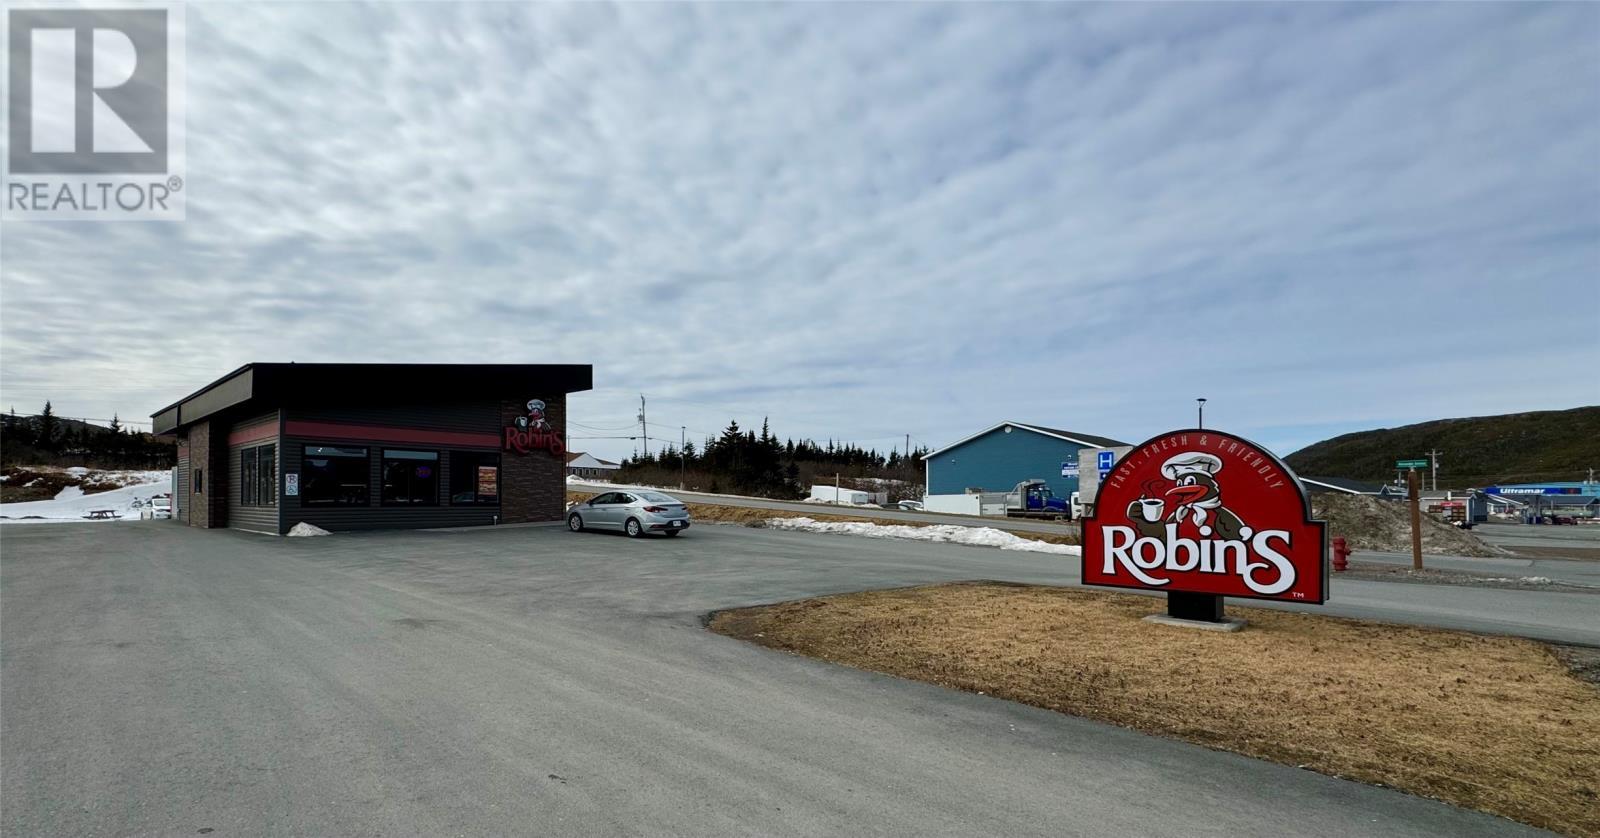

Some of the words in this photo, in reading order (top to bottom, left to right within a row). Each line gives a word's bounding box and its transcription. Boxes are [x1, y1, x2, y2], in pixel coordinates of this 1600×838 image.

[1099, 453, 1113, 468] H
[1143, 435, 1188, 458] FRESH
[1199, 434, 1208, 447] &
[1218, 438, 1285, 489] FRIENDLY
[1499, 487, 1546, 495] Ultramar
